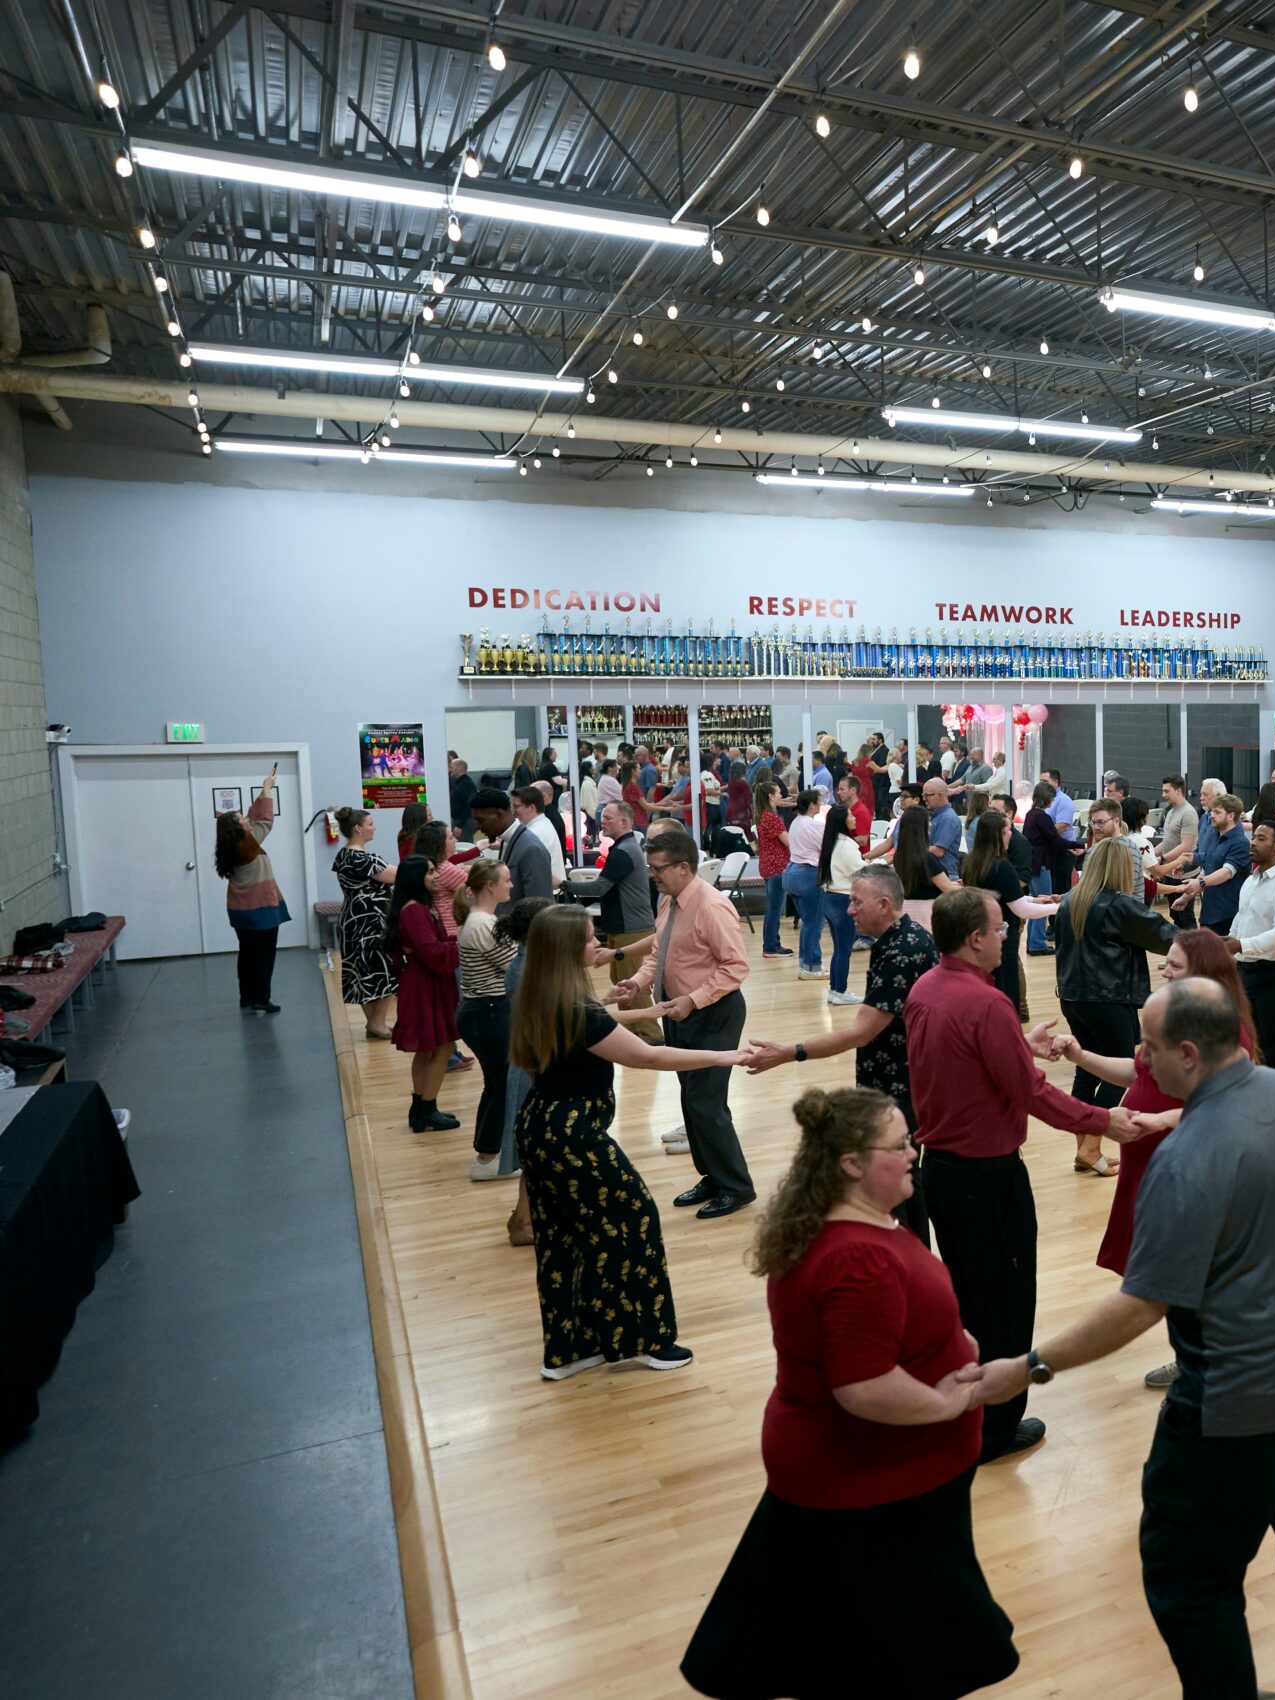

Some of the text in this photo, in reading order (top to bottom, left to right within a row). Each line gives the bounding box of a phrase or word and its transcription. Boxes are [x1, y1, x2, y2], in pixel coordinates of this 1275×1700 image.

[467, 586, 661, 614] DEDICATION
[748, 595, 858, 620] RESPECT
[935, 602, 1075, 626] TEAMWORK
[1119, 608, 1242, 630] LEADERSHIP
[173, 723, 200, 740] EXIT
